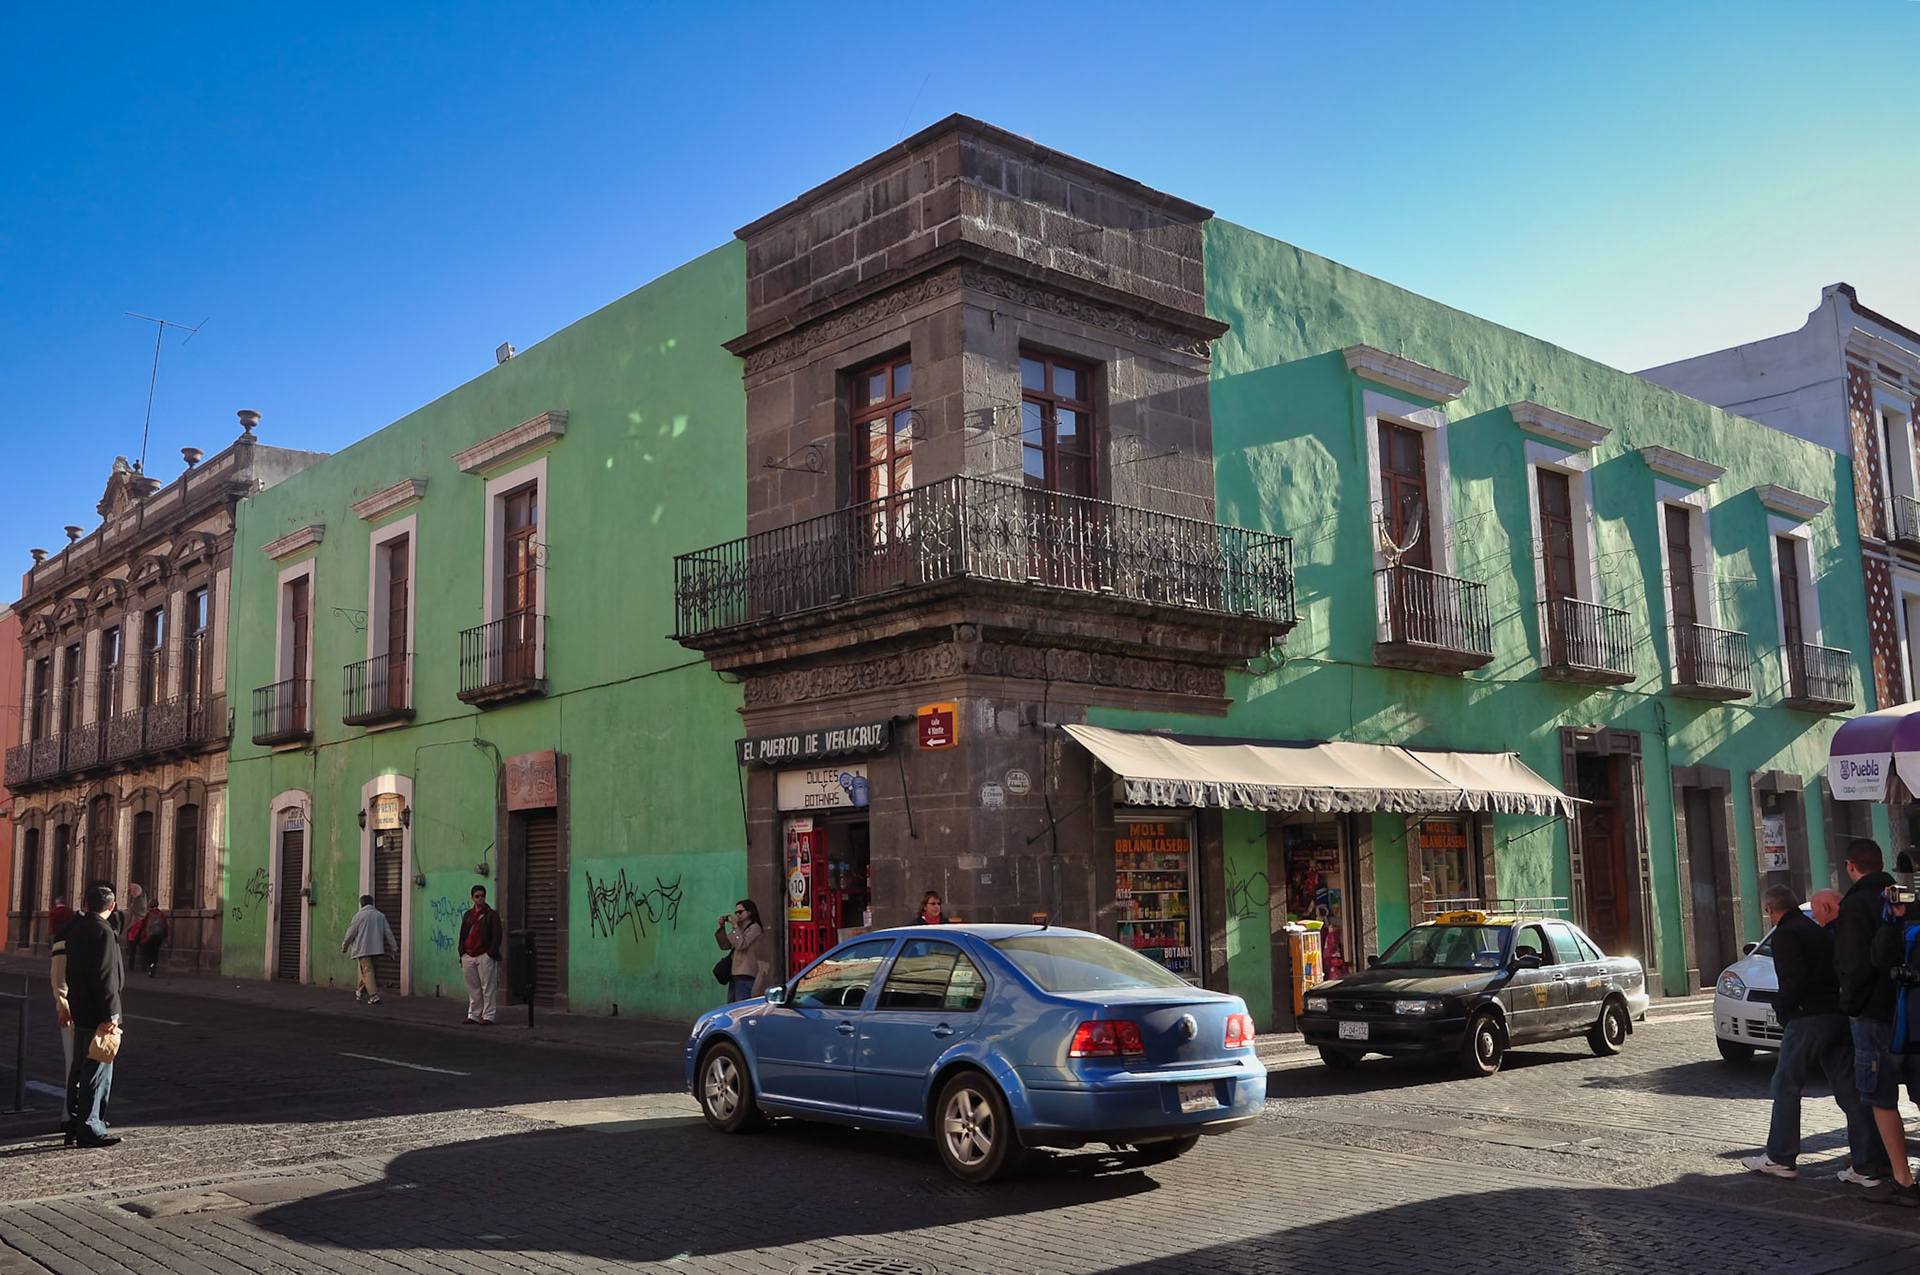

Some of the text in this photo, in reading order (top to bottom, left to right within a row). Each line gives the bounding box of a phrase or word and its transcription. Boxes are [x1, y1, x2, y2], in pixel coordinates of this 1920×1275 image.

[743, 724, 882, 760] EL PUERTO DE VERACRUZ
[1850, 759, 1879, 777] Puebla
[806, 769, 839, 784] DULCES
[820, 784, 828, 792] Y
[804, 792, 839, 807] BOTANAS
[1129, 823, 1165, 836] MOLE
[1426, 822, 1452, 832] MOLE
[1115, 839, 1189, 853] OBLANO CASERO
[1164, 947, 1193, 959] BOTANAS
[1166, 960, 1190, 970] HIELO
